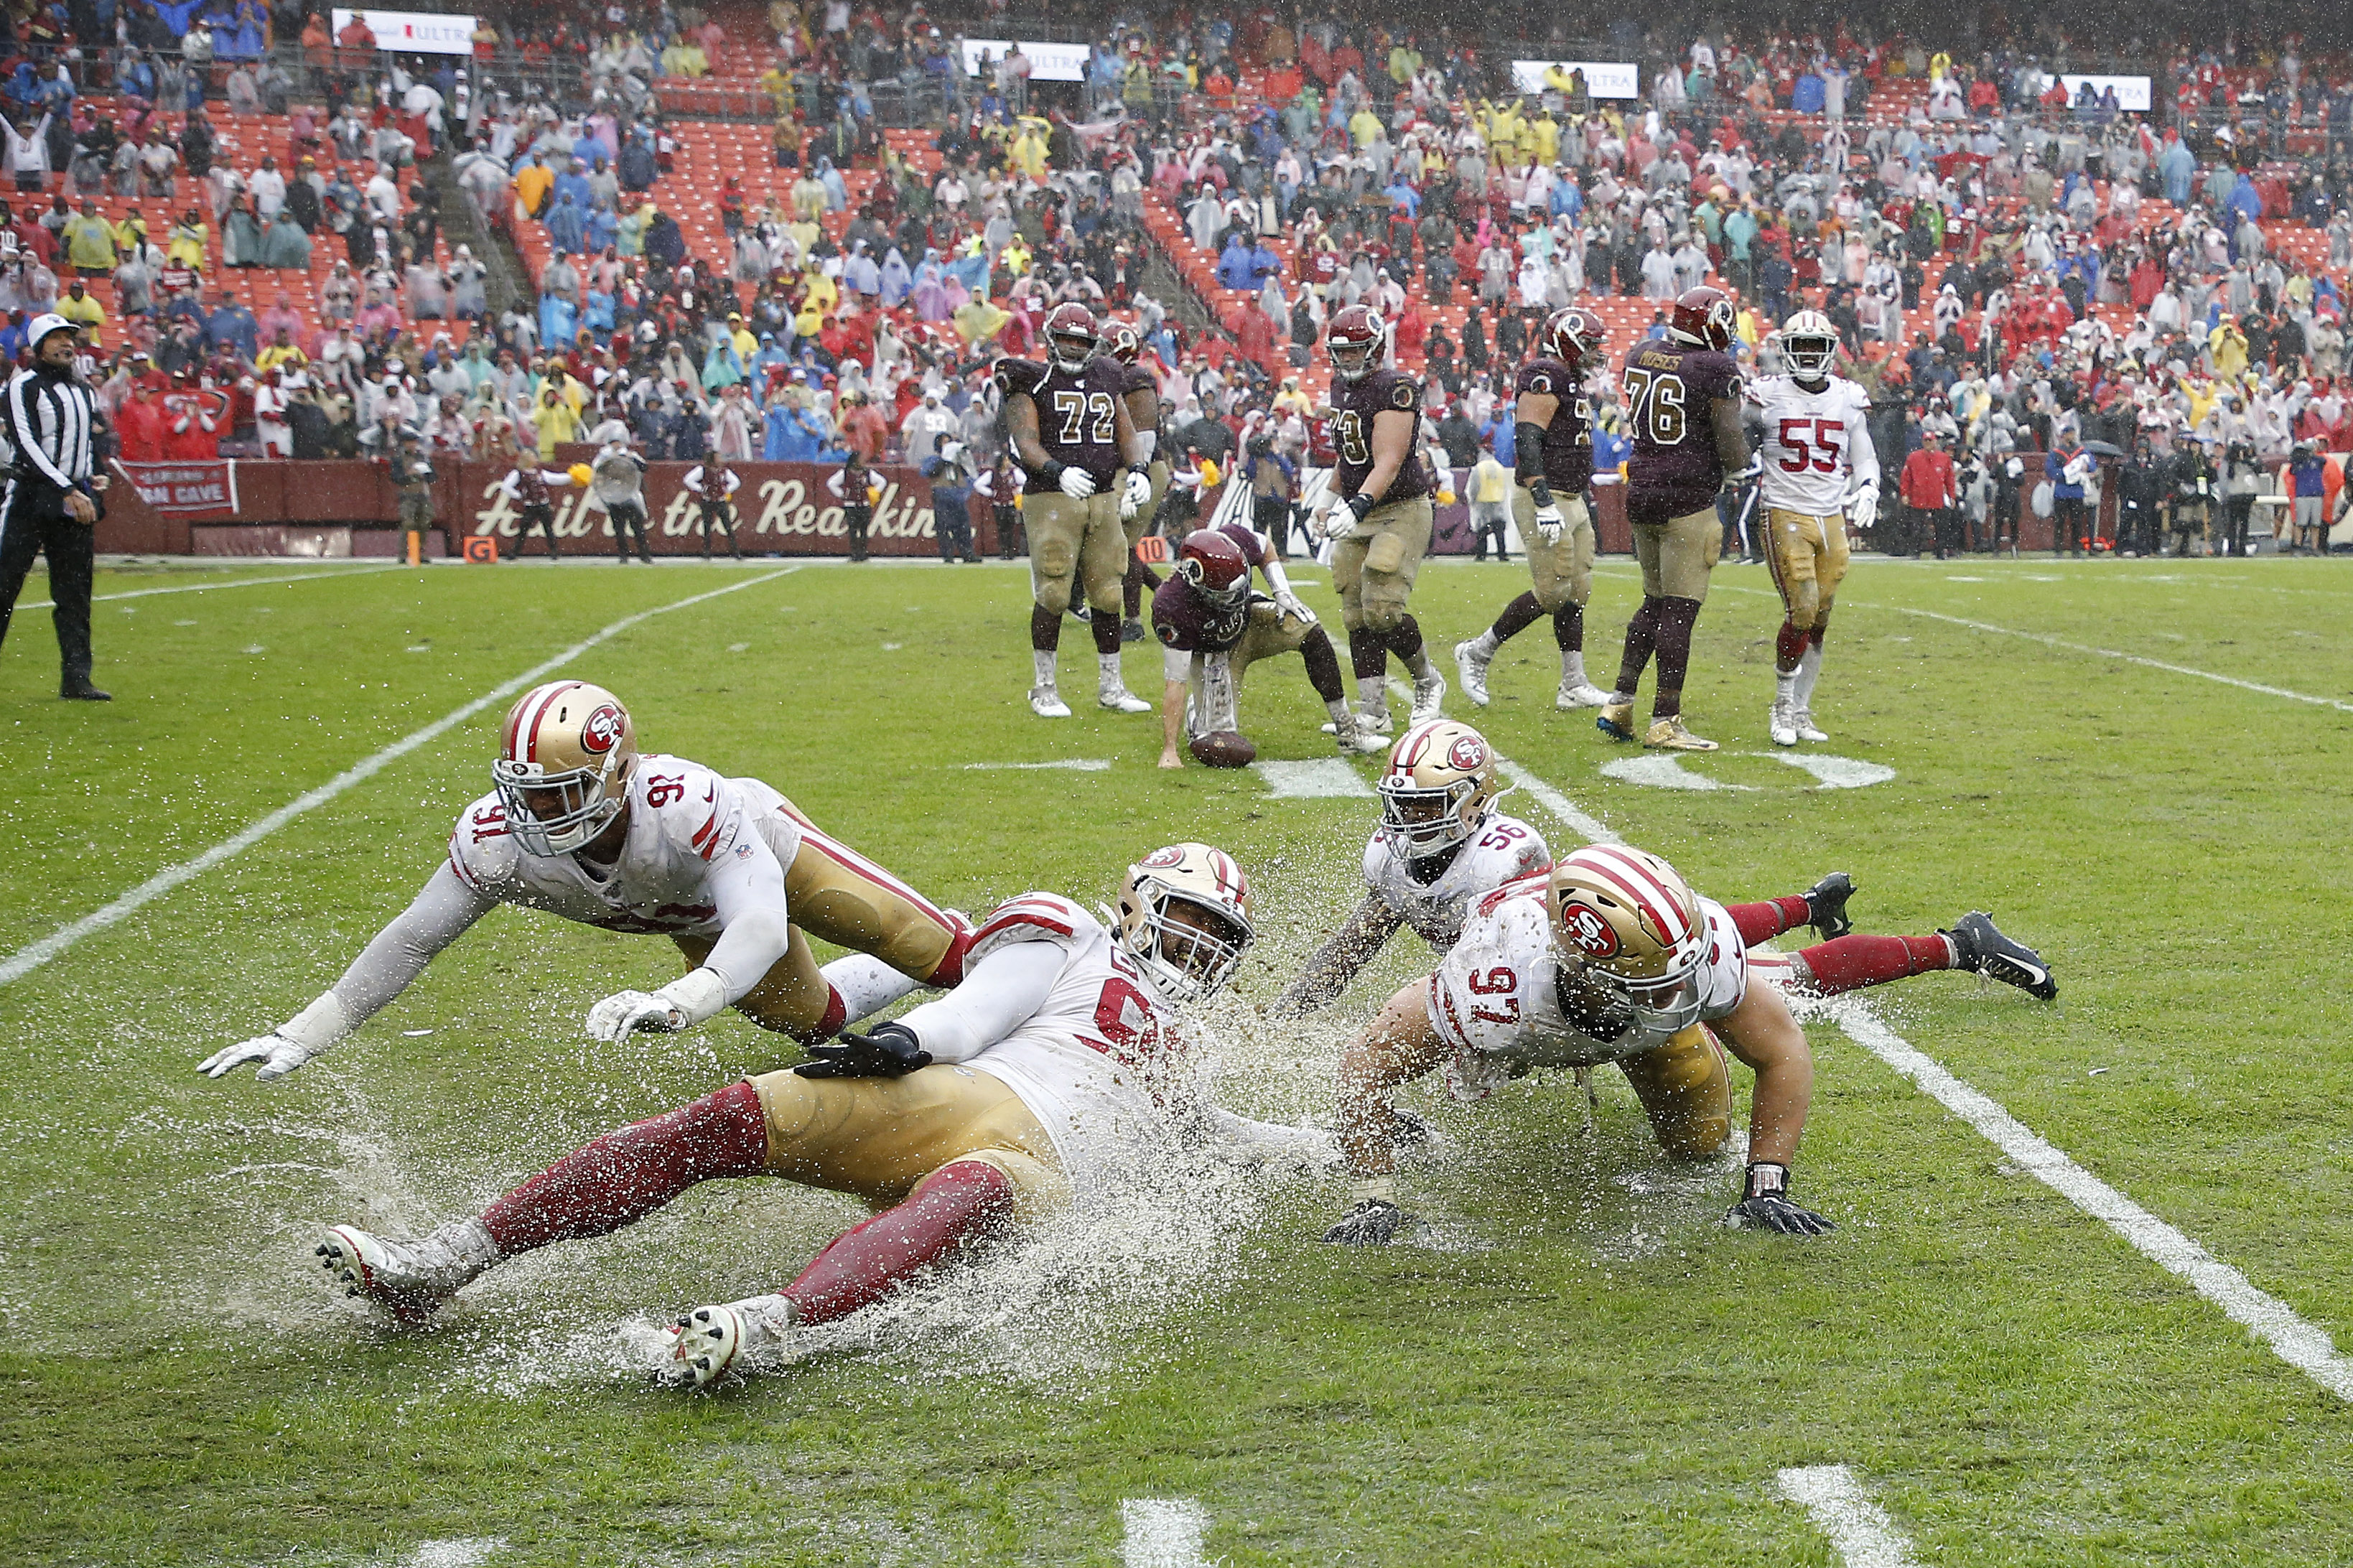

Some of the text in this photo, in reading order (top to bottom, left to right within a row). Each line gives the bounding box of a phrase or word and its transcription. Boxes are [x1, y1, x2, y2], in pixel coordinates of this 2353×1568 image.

[925, 412, 948, 432] 93
[1053, 391, 1115, 444] 72
[1625, 367, 1687, 445] 76
[1779, 419, 1844, 472] 55
[470, 540, 490, 561] G
[1140, 540, 1162, 559] 10
[1479, 823, 1527, 851] 56
[1468, 966, 1521, 1025] 97
